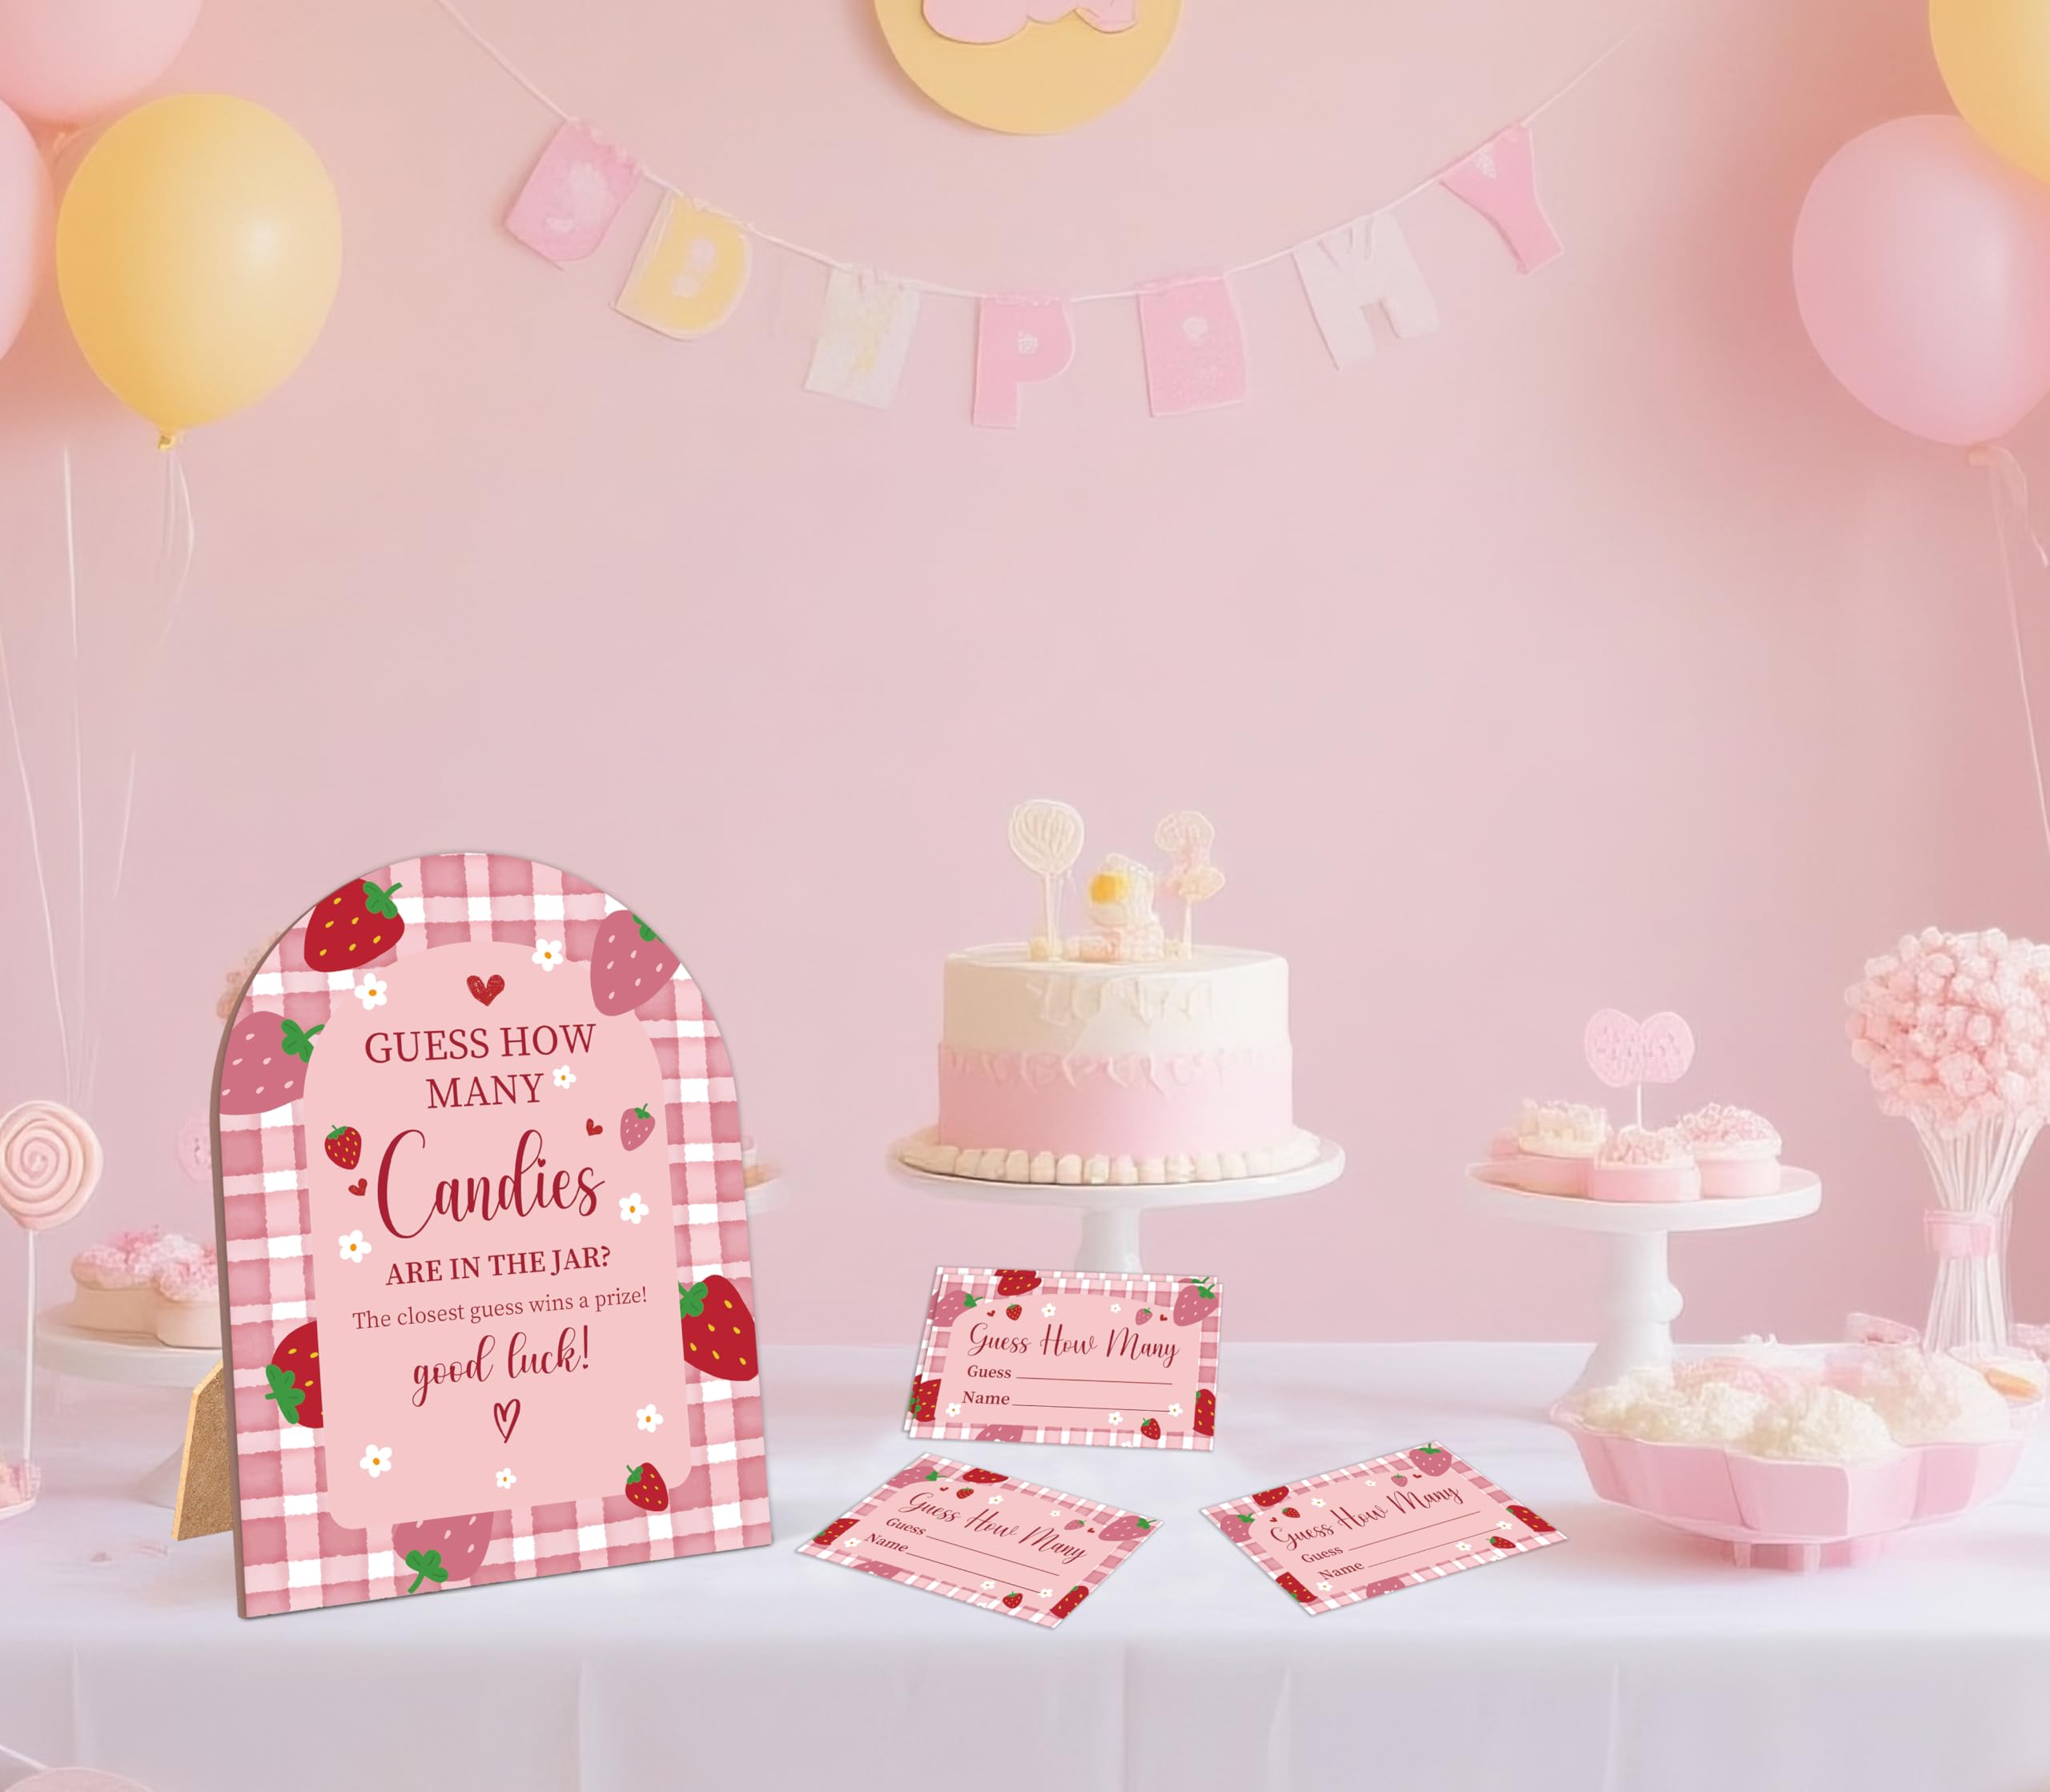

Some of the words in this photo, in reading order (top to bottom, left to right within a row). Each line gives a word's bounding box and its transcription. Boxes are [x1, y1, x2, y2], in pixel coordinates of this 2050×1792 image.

[364, 1027, 489, 1064] GUESS
[499, 1023, 597, 1058] HOW
[425, 1072, 545, 1110] MANY
[376, 1129, 605, 1240] Candies
[385, 1259, 446, 1288] ARE
[448, 1256, 481, 1280] IN
[487, 1251, 546, 1276] THE
[549, 1245, 611, 1276] JAR?
[352, 1311, 391, 1330] The
[397, 1304, 465, 1326] closest
[470, 1301, 524, 1324] guess
[528, 1295, 574, 1314] wins
[579, 1296, 590, 1308] a
[594, 1285, 647, 1312] prize!
[967, 1322, 1031, 1356] Guess
[1039, 1323, 1097, 1357] How
[1106, 1327, 1180, 1368] Many
[412, 1334, 496, 1408] good
[507, 1324, 589, 1380] luck!
[967, 1364, 1012, 1379] Guess
[962, 1391, 1011, 1405] Name
[886, 1517, 927, 1537] Guess
[898, 1492, 961, 1522] Guess
[964, 1508, 1020, 1537] How
[1019, 1526, 1089, 1565] Many
[1270, 1525, 1335, 1551] Guess
[1330, 1506, 1389, 1531] How
[1386, 1485, 1464, 1515] Many
[864, 1533, 909, 1553] Name
[1300, 1546, 1344, 1564] Guess
[1318, 1564, 1365, 1581] Name
